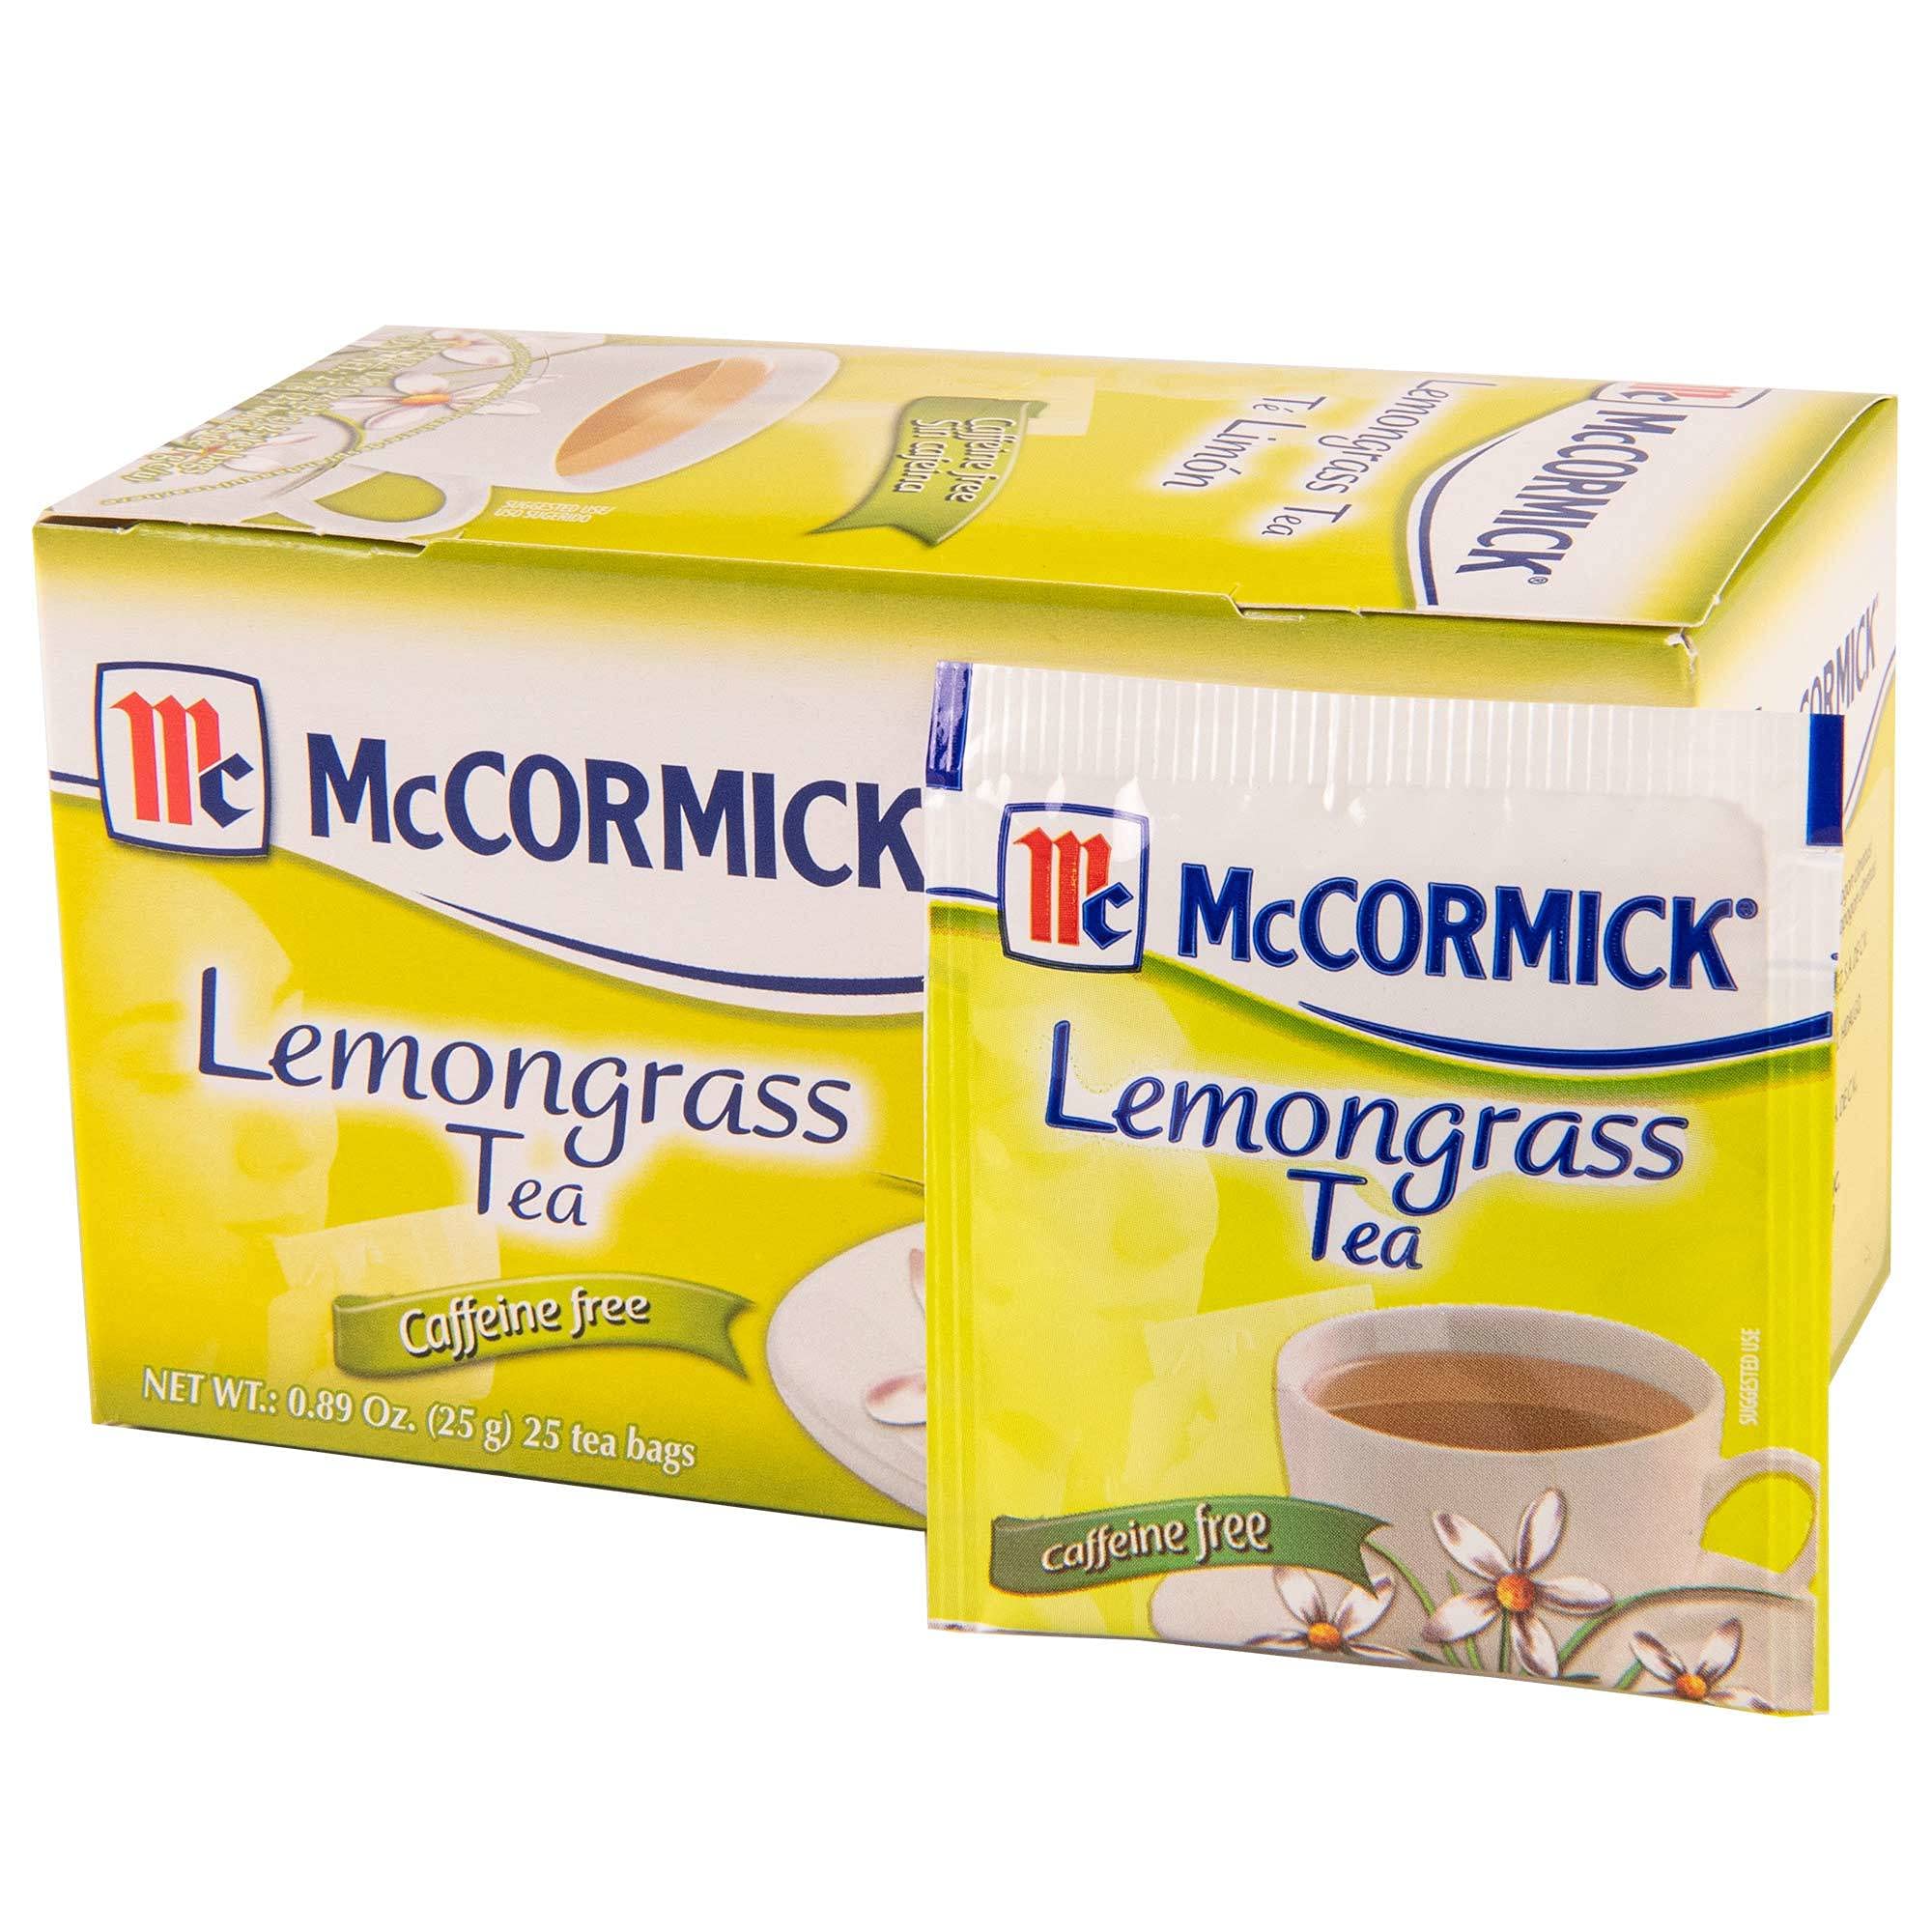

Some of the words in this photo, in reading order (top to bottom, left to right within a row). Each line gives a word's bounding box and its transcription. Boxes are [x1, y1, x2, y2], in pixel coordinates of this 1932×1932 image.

[912, 418, 962, 438] Sin
[1252, 396, 1327, 413] Té
[1305, 379, 1497, 494] Lemongrass
[952, 417, 1019, 470] Caffeine
[1162, 418, 1307, 488] Limón
[502, 500, 581, 513] SUGGESTED
[947, 469, 999, 501] free
[1261, 503, 1352, 537] Tea
[305, 732, 925, 893] McCORMICK
[198, 966, 851, 1168] Lemongrass
[1044, 1019, 1690, 1216] Lemongrass
[445, 1122, 587, 1227] Tea
[1286, 1168, 1424, 1270] Tea
[399, 1293, 560, 1359] Caffeine
[569, 1286, 650, 1337] free
[1740, 1328, 1761, 1352] USE
[142, 1366, 205, 1406] NET
[212, 1376, 278, 1414] WT.:
[287, 1386, 353, 1423] 0.89
[363, 1395, 416, 1432] Oz.
[427, 1404, 475, 1439] (25
[484, 1413, 512, 1453] g)
[523, 1416, 561, 1450] 25
[572, 1424, 616, 1458] tea
[627, 1425, 696, 1475] bags
[1739, 1354, 1760, 1426] SUGGESTED
[1041, 1519, 1187, 1573] caffeine
[1195, 1502, 1270, 1565] free
